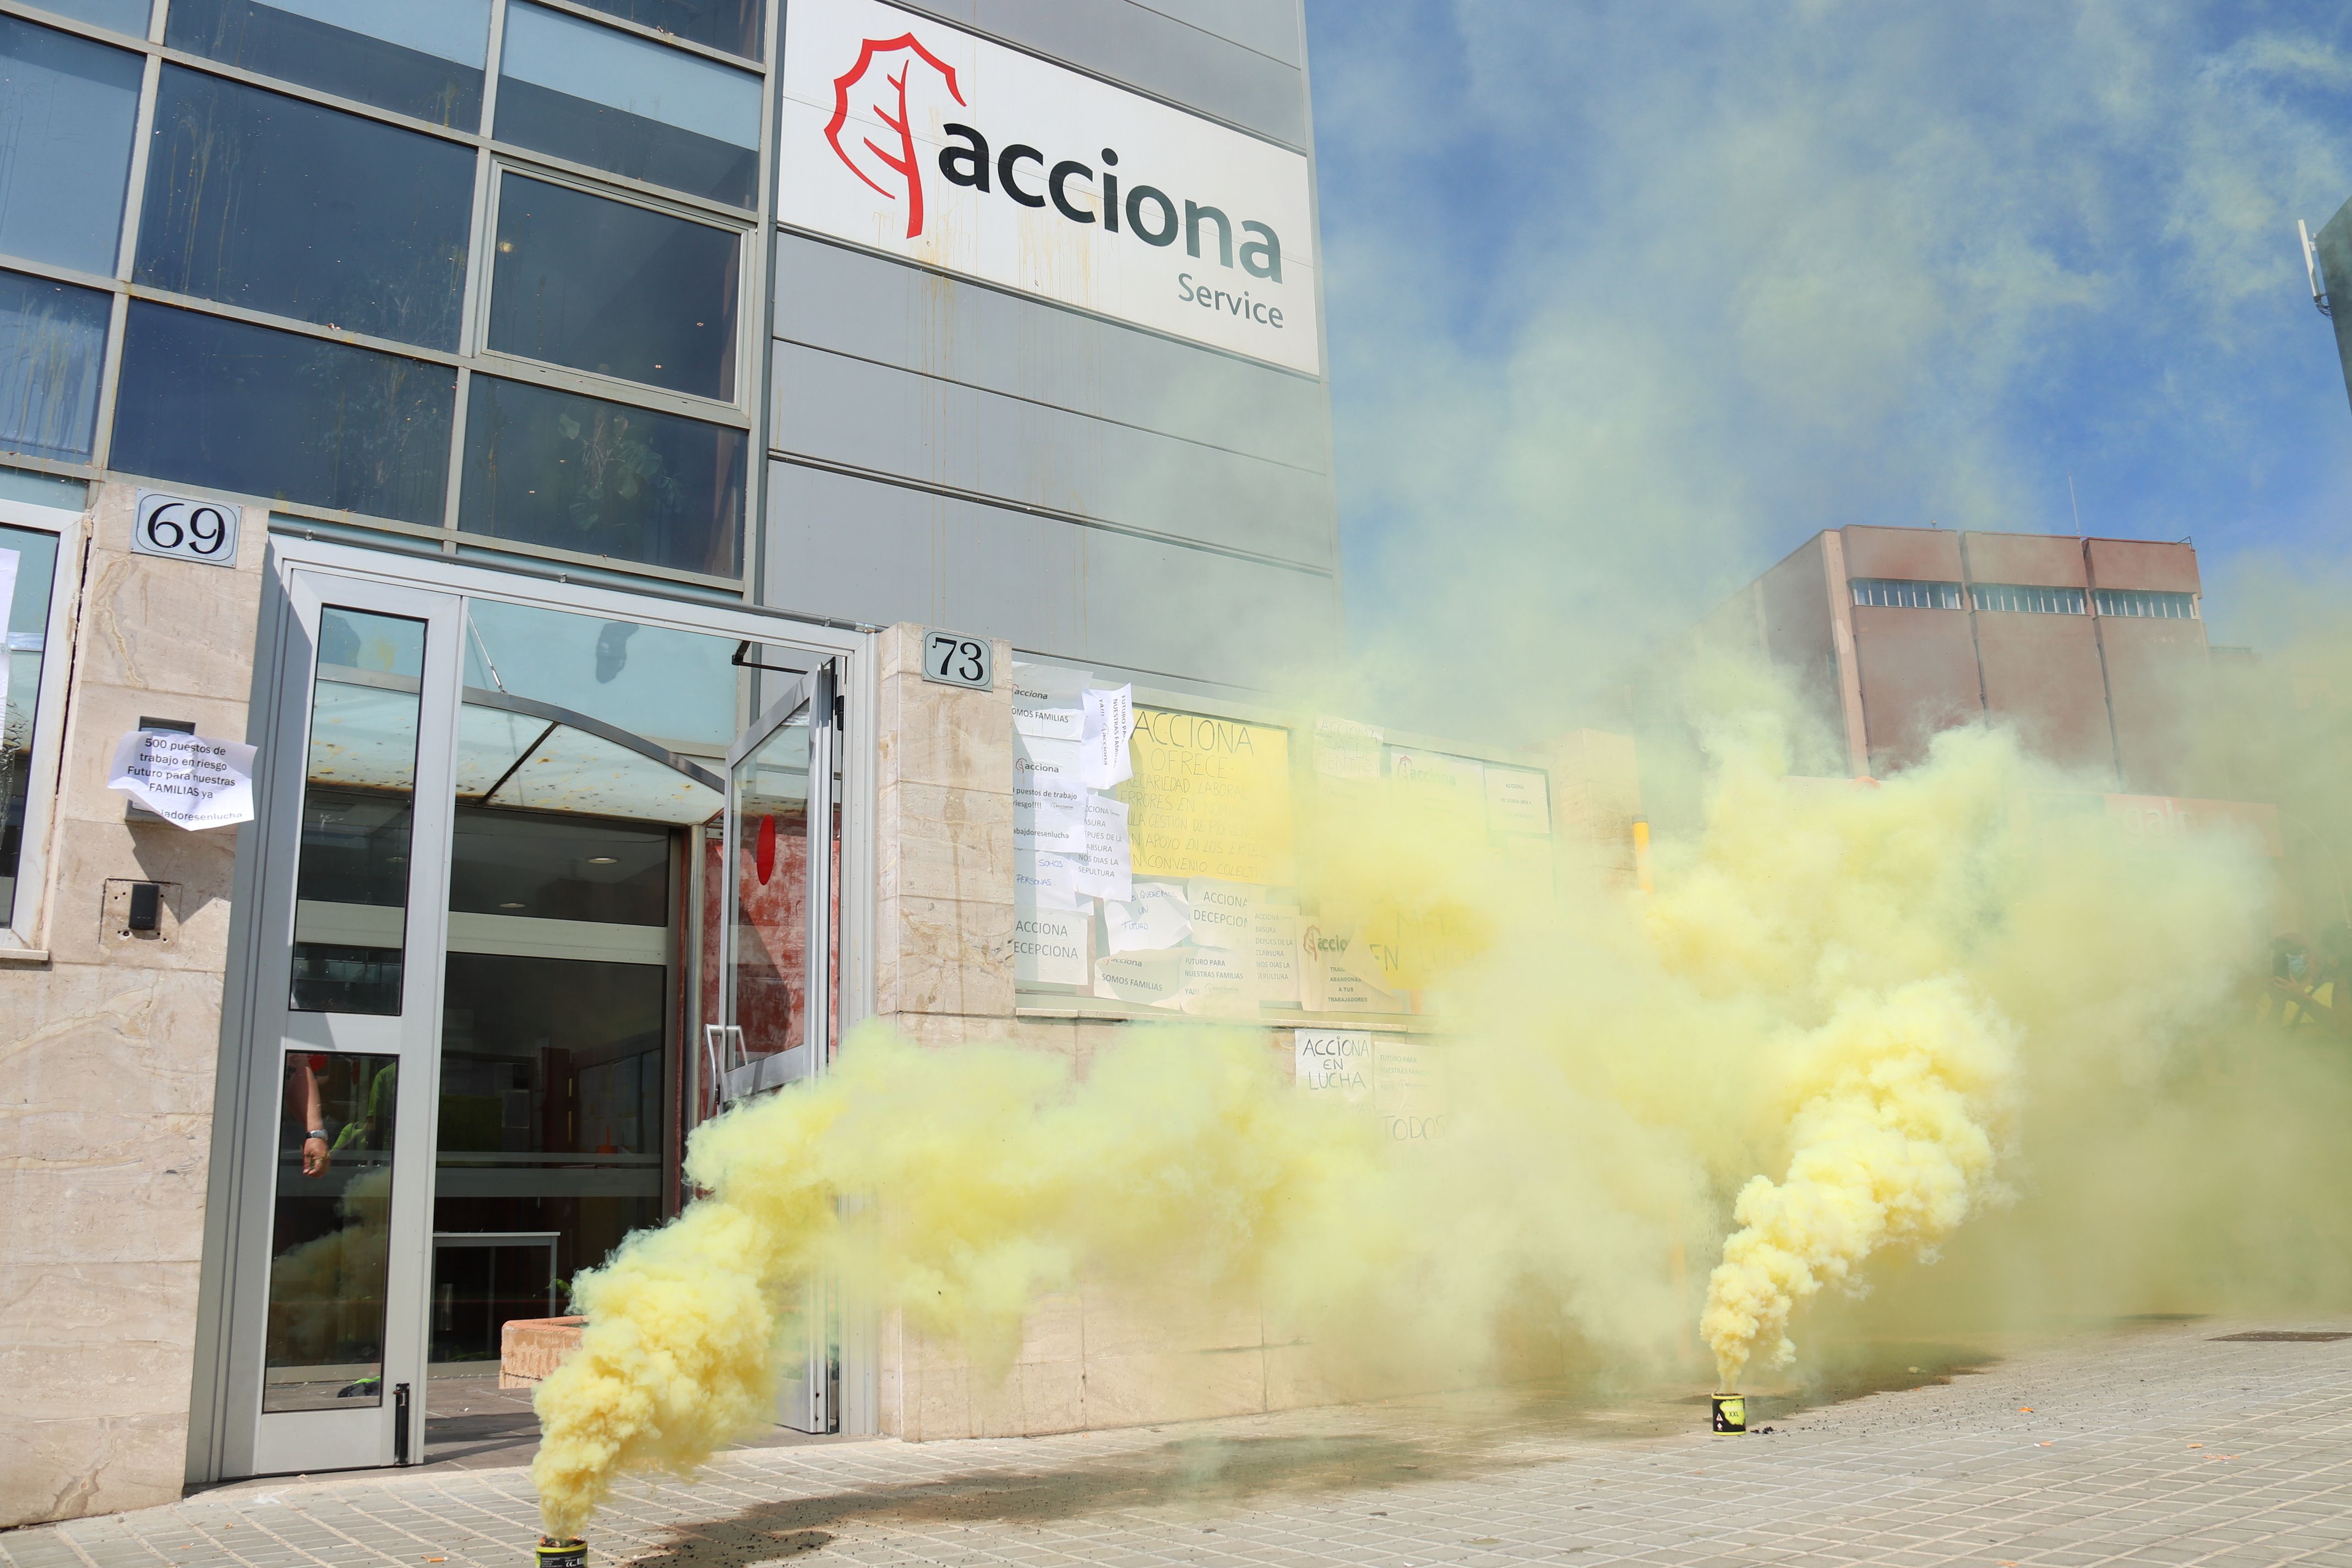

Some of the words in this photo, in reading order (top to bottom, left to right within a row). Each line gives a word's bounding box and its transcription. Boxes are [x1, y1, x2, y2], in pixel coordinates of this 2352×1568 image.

[939, 123, 1283, 285] acciona
[1178, 274, 1284, 329] Service
[147, 503, 226, 554] 69
[932, 637, 983, 680] 73
[1014, 689, 1048, 700] acciona
[1012, 707, 1033, 718] OMOS
[1036, 711, 1069, 723] FAMILIAS
[1129, 711, 1255, 756] ACCIONA
[1320, 717, 1378, 745] ACCIONA
[145, 738, 167, 749] 500
[170, 742, 211, 754] puestos
[213, 746, 226, 755] de
[1355, 742, 1374, 761] DE
[140, 752, 179, 766] trabajo
[182, 758, 194, 766] en
[197, 759, 227, 772] riesgo
[1025, 763, 1059, 773] acciona
[1150, 748, 1230, 779] OFRECE
[127, 765, 163, 778] Futuro
[166, 771, 190, 780] para
[193, 775, 236, 786] nuestras
[1409, 767, 1457, 788] acciona
[149, 783, 200, 797] FAMILIAS
[202, 790, 214, 799] ya
[1016, 788, 1042, 797] puestos
[1053, 791, 1077, 801] trabajo
[1120, 772, 1190, 793] ECARIEDAD
[1197, 781, 1251, 800] LABORAL
[1177, 797, 1195, 813] EN
[1127, 810, 1146, 826] ULA
[1193, 819, 1205, 832] DE
[1145, 834, 1180, 850] APOYO
[1185, 838, 1199, 851] EN
[1202, 839, 1224, 853] LOS
[1079, 854, 1092, 862] NOS
[1093, 856, 1108, 865] DIAS
[1147, 854, 1208, 872] CONVENIO
[1078, 866, 1115, 878] SEPULTURA
[1137, 903, 1149, 914] UN
[1121, 920, 1149, 930] FUTURO
[1194, 909, 1248, 928] DECEPCION
[1015, 920, 1068, 937] ACCIONA
[1014, 941, 1079, 959] ECEPCIONA
[1317, 934, 1351, 952] accio
[1110, 956, 1142, 967] acciona
[1185, 957, 1208, 966] FUTURO
[1102, 973, 1129, 986] SOMOS
[1130, 978, 1163, 992] FAMILIAS
[1185, 970, 1215, 978] NUESTRAS
[1216, 971, 1244, 979] FAMILIAS
[1322, 1058, 1344, 1071] EN
[1380, 1054, 1402, 1063] FUTURO
[1402, 1055, 1418, 1064] PARA
[1380, 1066, 1408, 1075] NUESTRAS
[1308, 1071, 1366, 1091] LUCHA
[1379, 1115, 1446, 1141] TODOS
